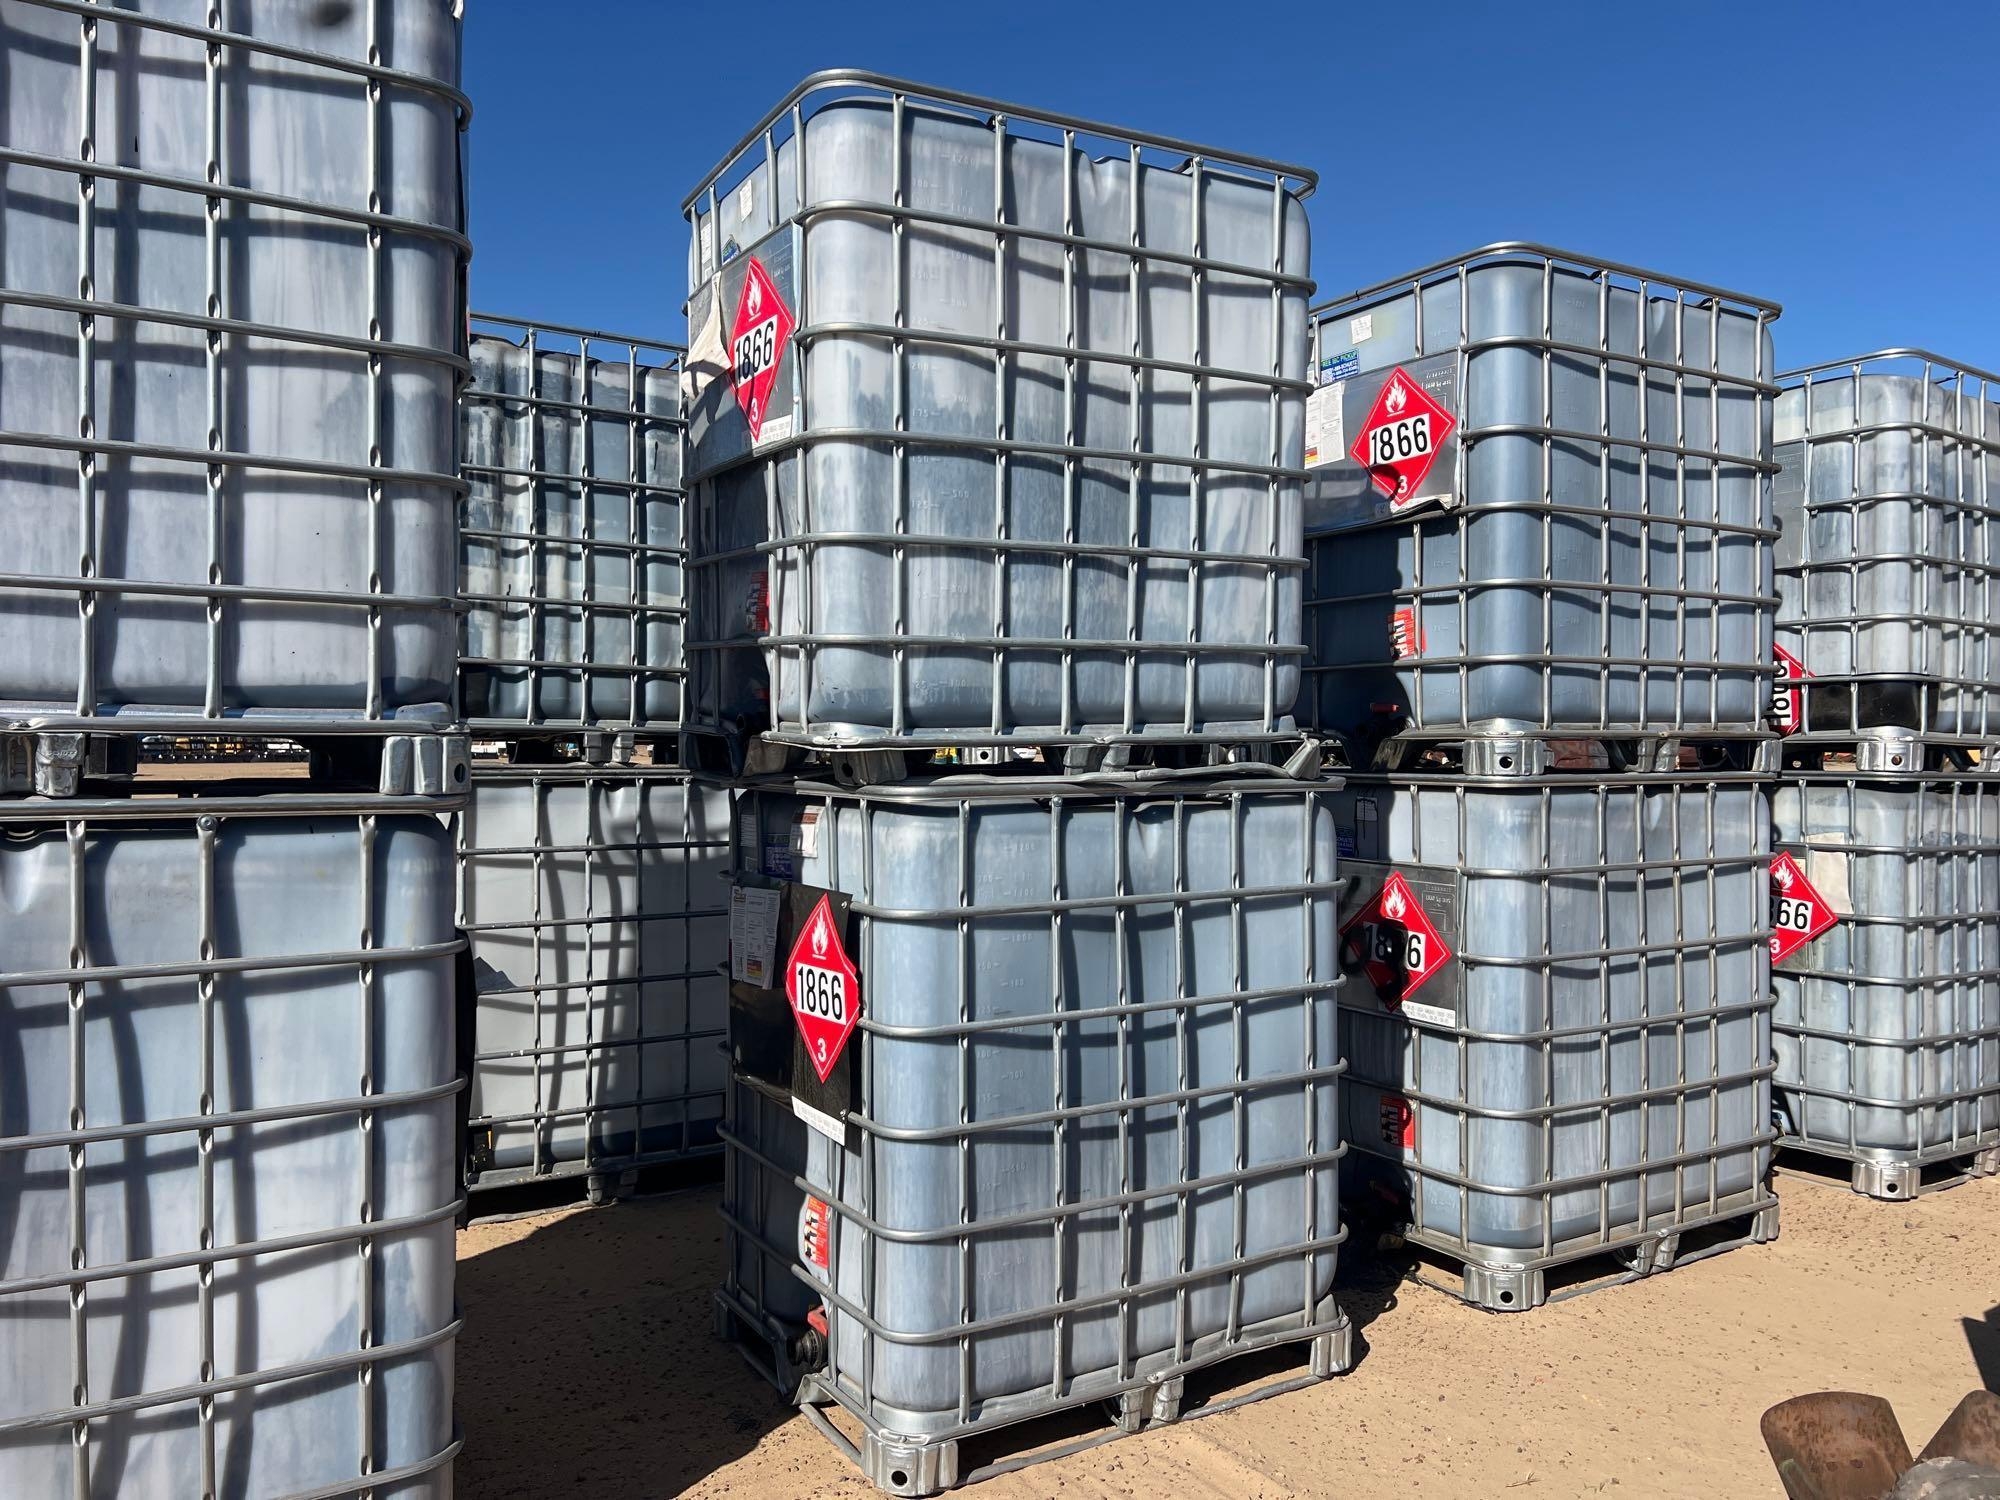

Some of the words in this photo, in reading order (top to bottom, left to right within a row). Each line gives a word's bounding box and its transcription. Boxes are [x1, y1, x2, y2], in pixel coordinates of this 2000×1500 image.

[736, 321, 774, 384] 1866
[751, 397, 759, 423] 3
[1372, 417, 1427, 465] 1866
[1398, 475, 1408, 494] 3
[1365, 925, 1421, 969] 186
[1770, 938, 1781, 954] 3
[798, 966, 843, 1021] 1866
[818, 1037, 827, 1063] 3
